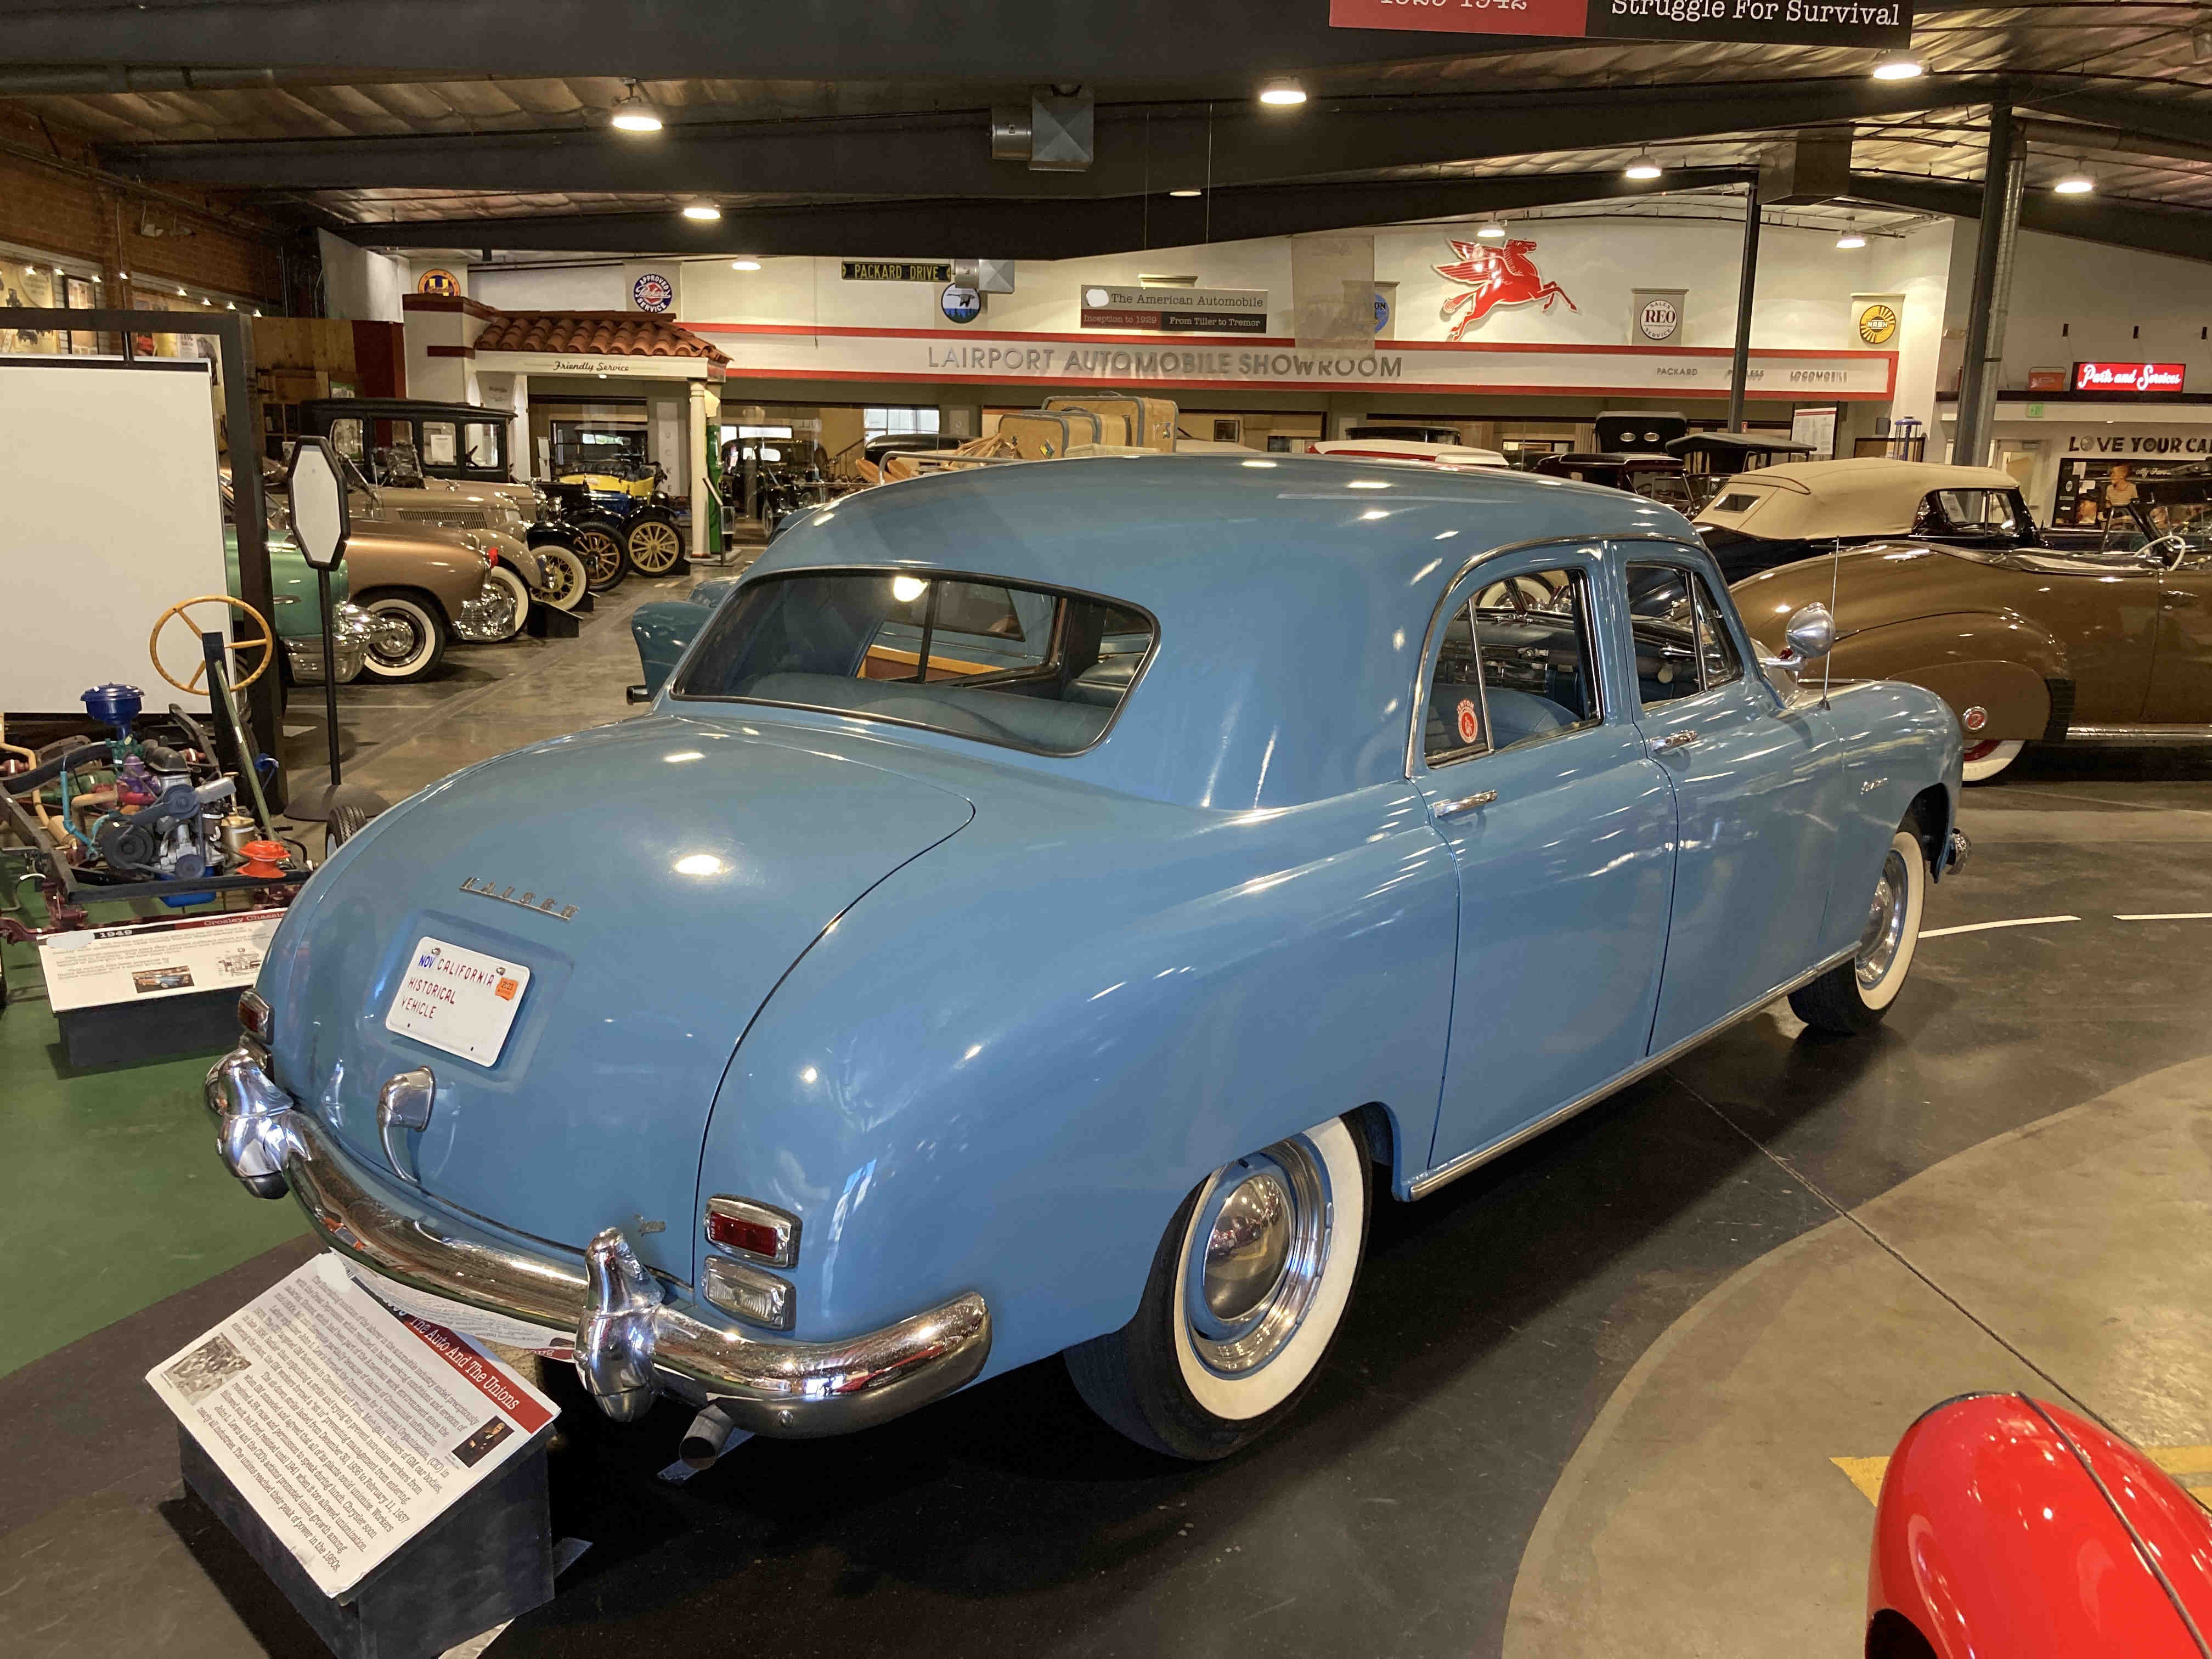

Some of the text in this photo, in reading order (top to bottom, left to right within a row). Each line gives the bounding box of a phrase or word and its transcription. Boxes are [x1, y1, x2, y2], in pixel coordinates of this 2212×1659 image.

[1612, 0, 1899, 25] Struggle For Survival
[854, 264, 939, 280] PACKARD DRIVE
[640, 275, 669, 290] APPROVED
[637, 297, 667, 312] SERVICE
[1111, 294, 1263, 307] The American Automobile
[1084, 315, 1123, 324] Inception
[1136, 315, 1157, 324] 1929
[1169, 317, 1192, 325] From
[1194, 317, 1217, 326] Tiller
[1229, 318, 1260, 327] Tremor
[1645, 309, 1675, 323] REO
[553, 361, 629, 371] Friendly Service
[928, 346, 1402, 377] LAIRPORT AUTOMOBILE SHOWROOM
[1657, 368, 1698, 376] PACKARD
[2114, 369, 2137, 383] and
[2069, 436, 2125, 452] LOVE
[2131, 437, 2182, 453] YOUR
[100, 929, 133, 939] 1949
[204, 917, 244, 928] Crosley
[419, 955, 495, 987] NOV CALIFORNIA
[409, 977, 456, 1005] HISTORICAL
[402, 996, 437, 1019] VEHICLE
[410, 1317, 520, 1410] The Auto And The Unions
[406, 1477, 423, 1495] from
